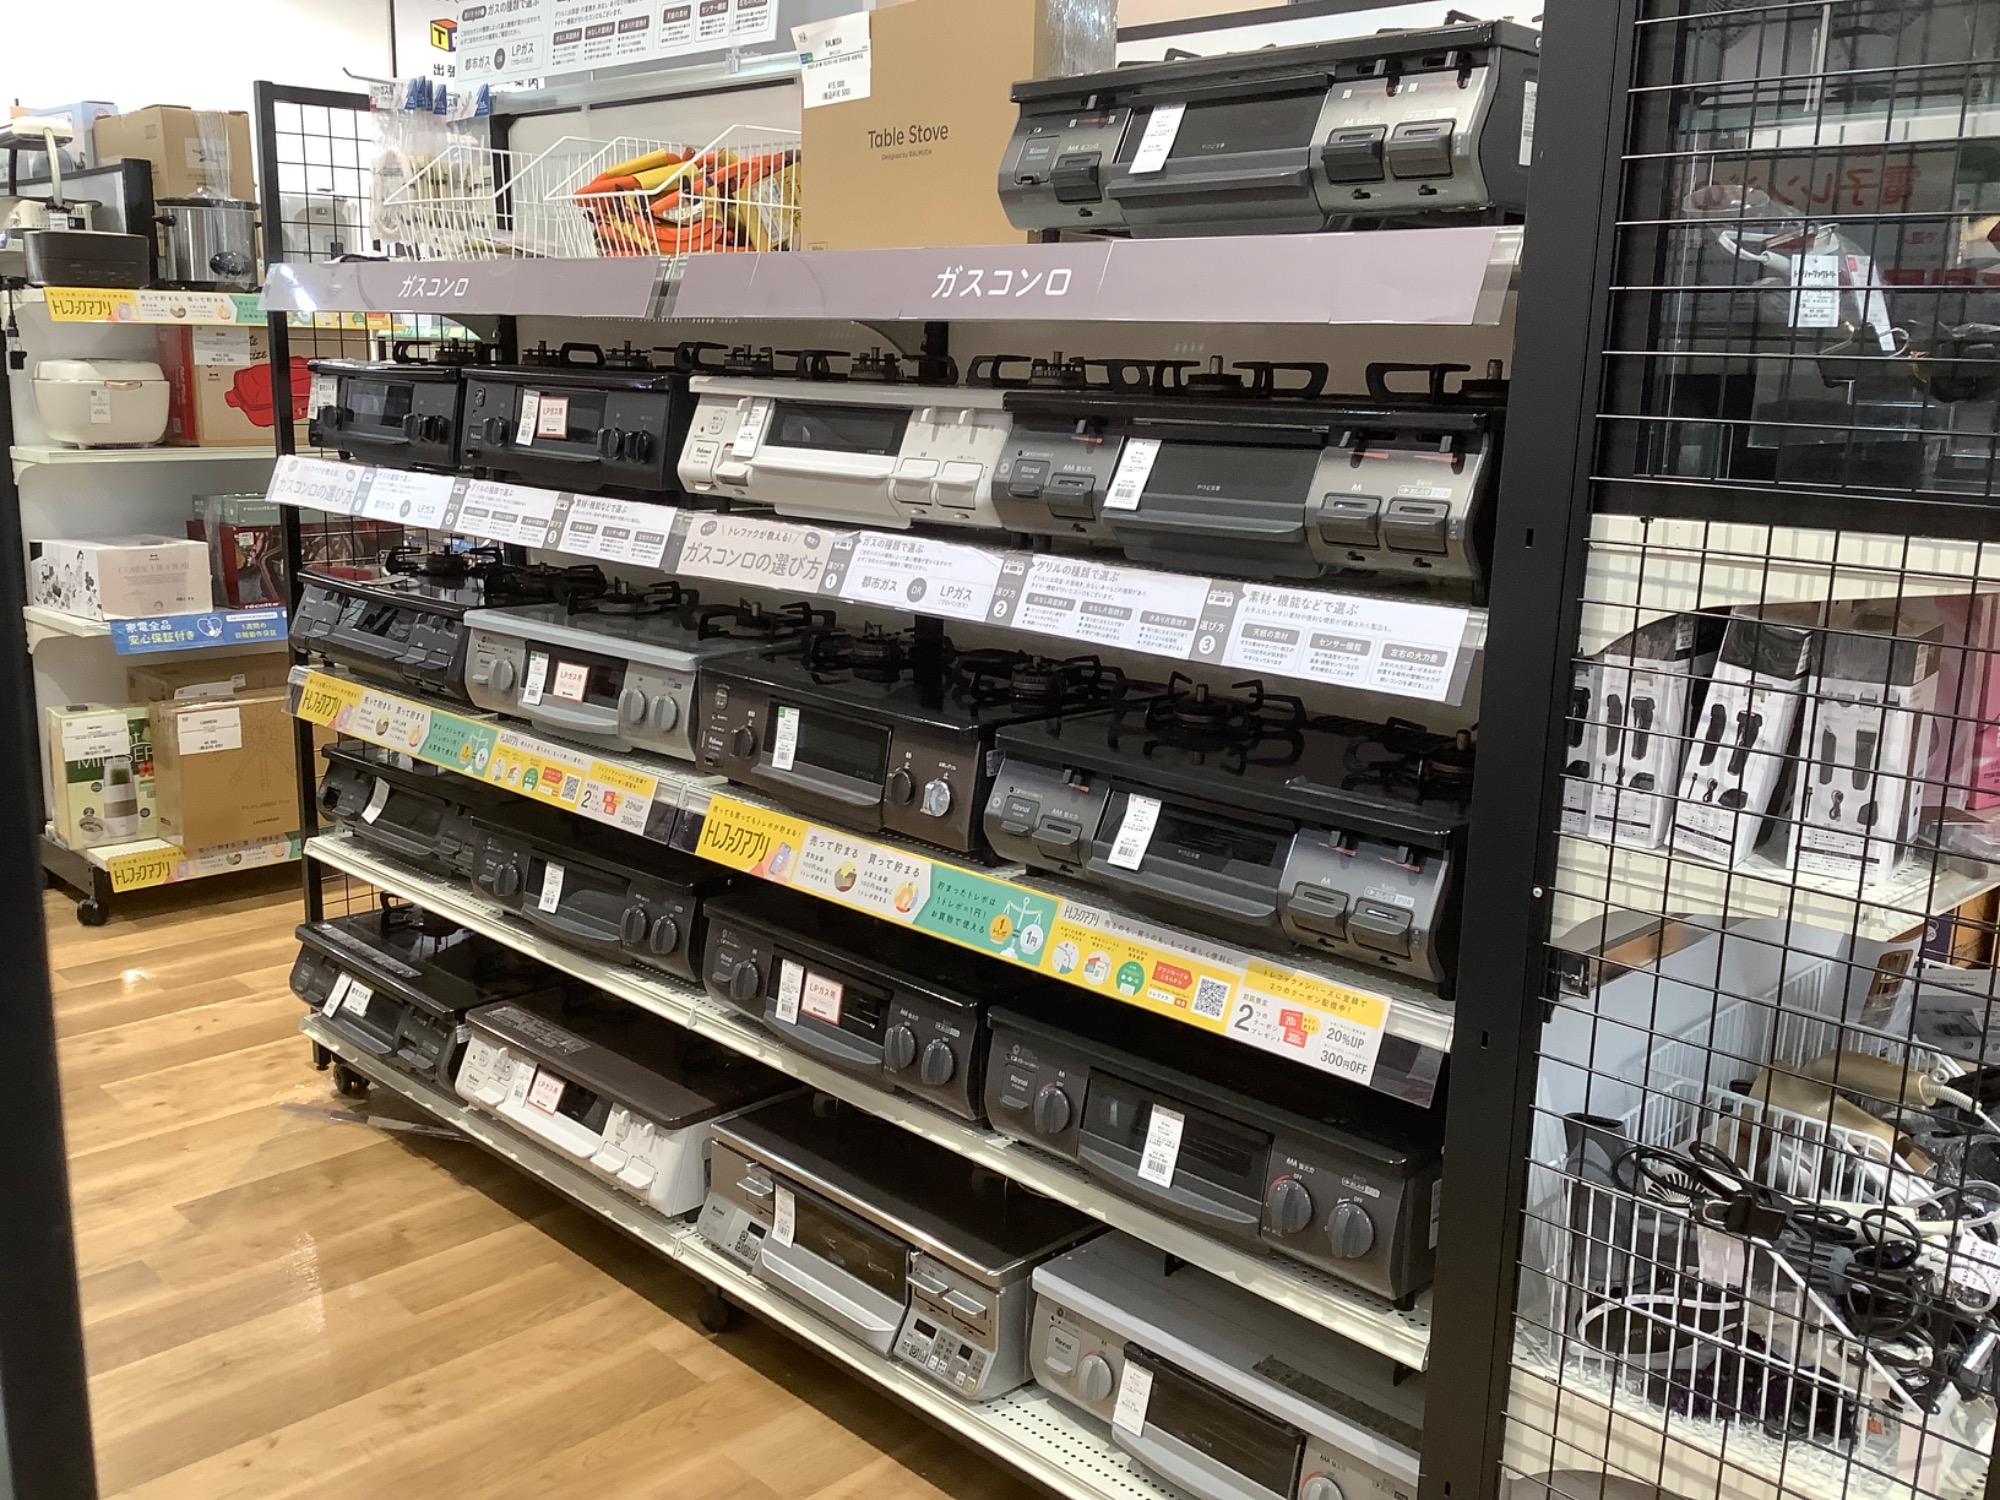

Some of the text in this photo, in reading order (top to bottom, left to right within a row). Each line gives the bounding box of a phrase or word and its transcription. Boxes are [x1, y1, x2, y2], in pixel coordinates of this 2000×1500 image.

[511, 42, 534, 57] LPガス
[868, 124, 949, 149] Table Stove
[397, 275, 470, 299] ガスコンロ
[931, 268, 1074, 300] ガスコンロ
[276, 477, 355, 507] ガスコンロの選び方
[862, 537, 924, 554] ガスの種類で選ぶ
[683, 541, 823, 581] ガスコンロの選び方
[1035, 560, 1120, 583] グリルの種類で選ぶ
[861, 575, 898, 593] 都市ガス
[910, 585, 922, 596] OR
[939, 585, 973, 602] LPガス
[995, 586, 1016, 599] 選び方
[996, 601, 1006, 616] 2
[1248, 590, 1360, 616] 素材・機能などで選ぶ
[125, 620, 172, 634] 家電全品
[127, 630, 196, 646] 安心保証付き
[1199, 619, 1227, 634] 選び方
[1252, 627, 1289, 641] 天板の素材
[1202, 638, 1212, 652] 3
[1319, 638, 1363, 653] センサー機能
[581, 790, 592, 809] 2
[703, 818, 771, 862] トレファクアプリ
[808, 835, 859, 859] 売って貯まる
[867, 853, 921, 878] 買って貯まる
[937, 880, 997, 907] 貯まったトレポは
[931, 910, 985, 935] お買物で使える
[1026, 930, 1038, 948] 1円
[809, 981, 837, 1001] LPガス用
[1262, 968, 1368, 1008] トレファクメンバーズに登録で
[1269, 982, 1352, 1015] 2つのクーポン配信中!
[1233, 1003, 1254, 1032] 2
[1326, 1027, 1366, 1050] 20%UP
[1320, 1049, 1369, 1076] 300円OFF
